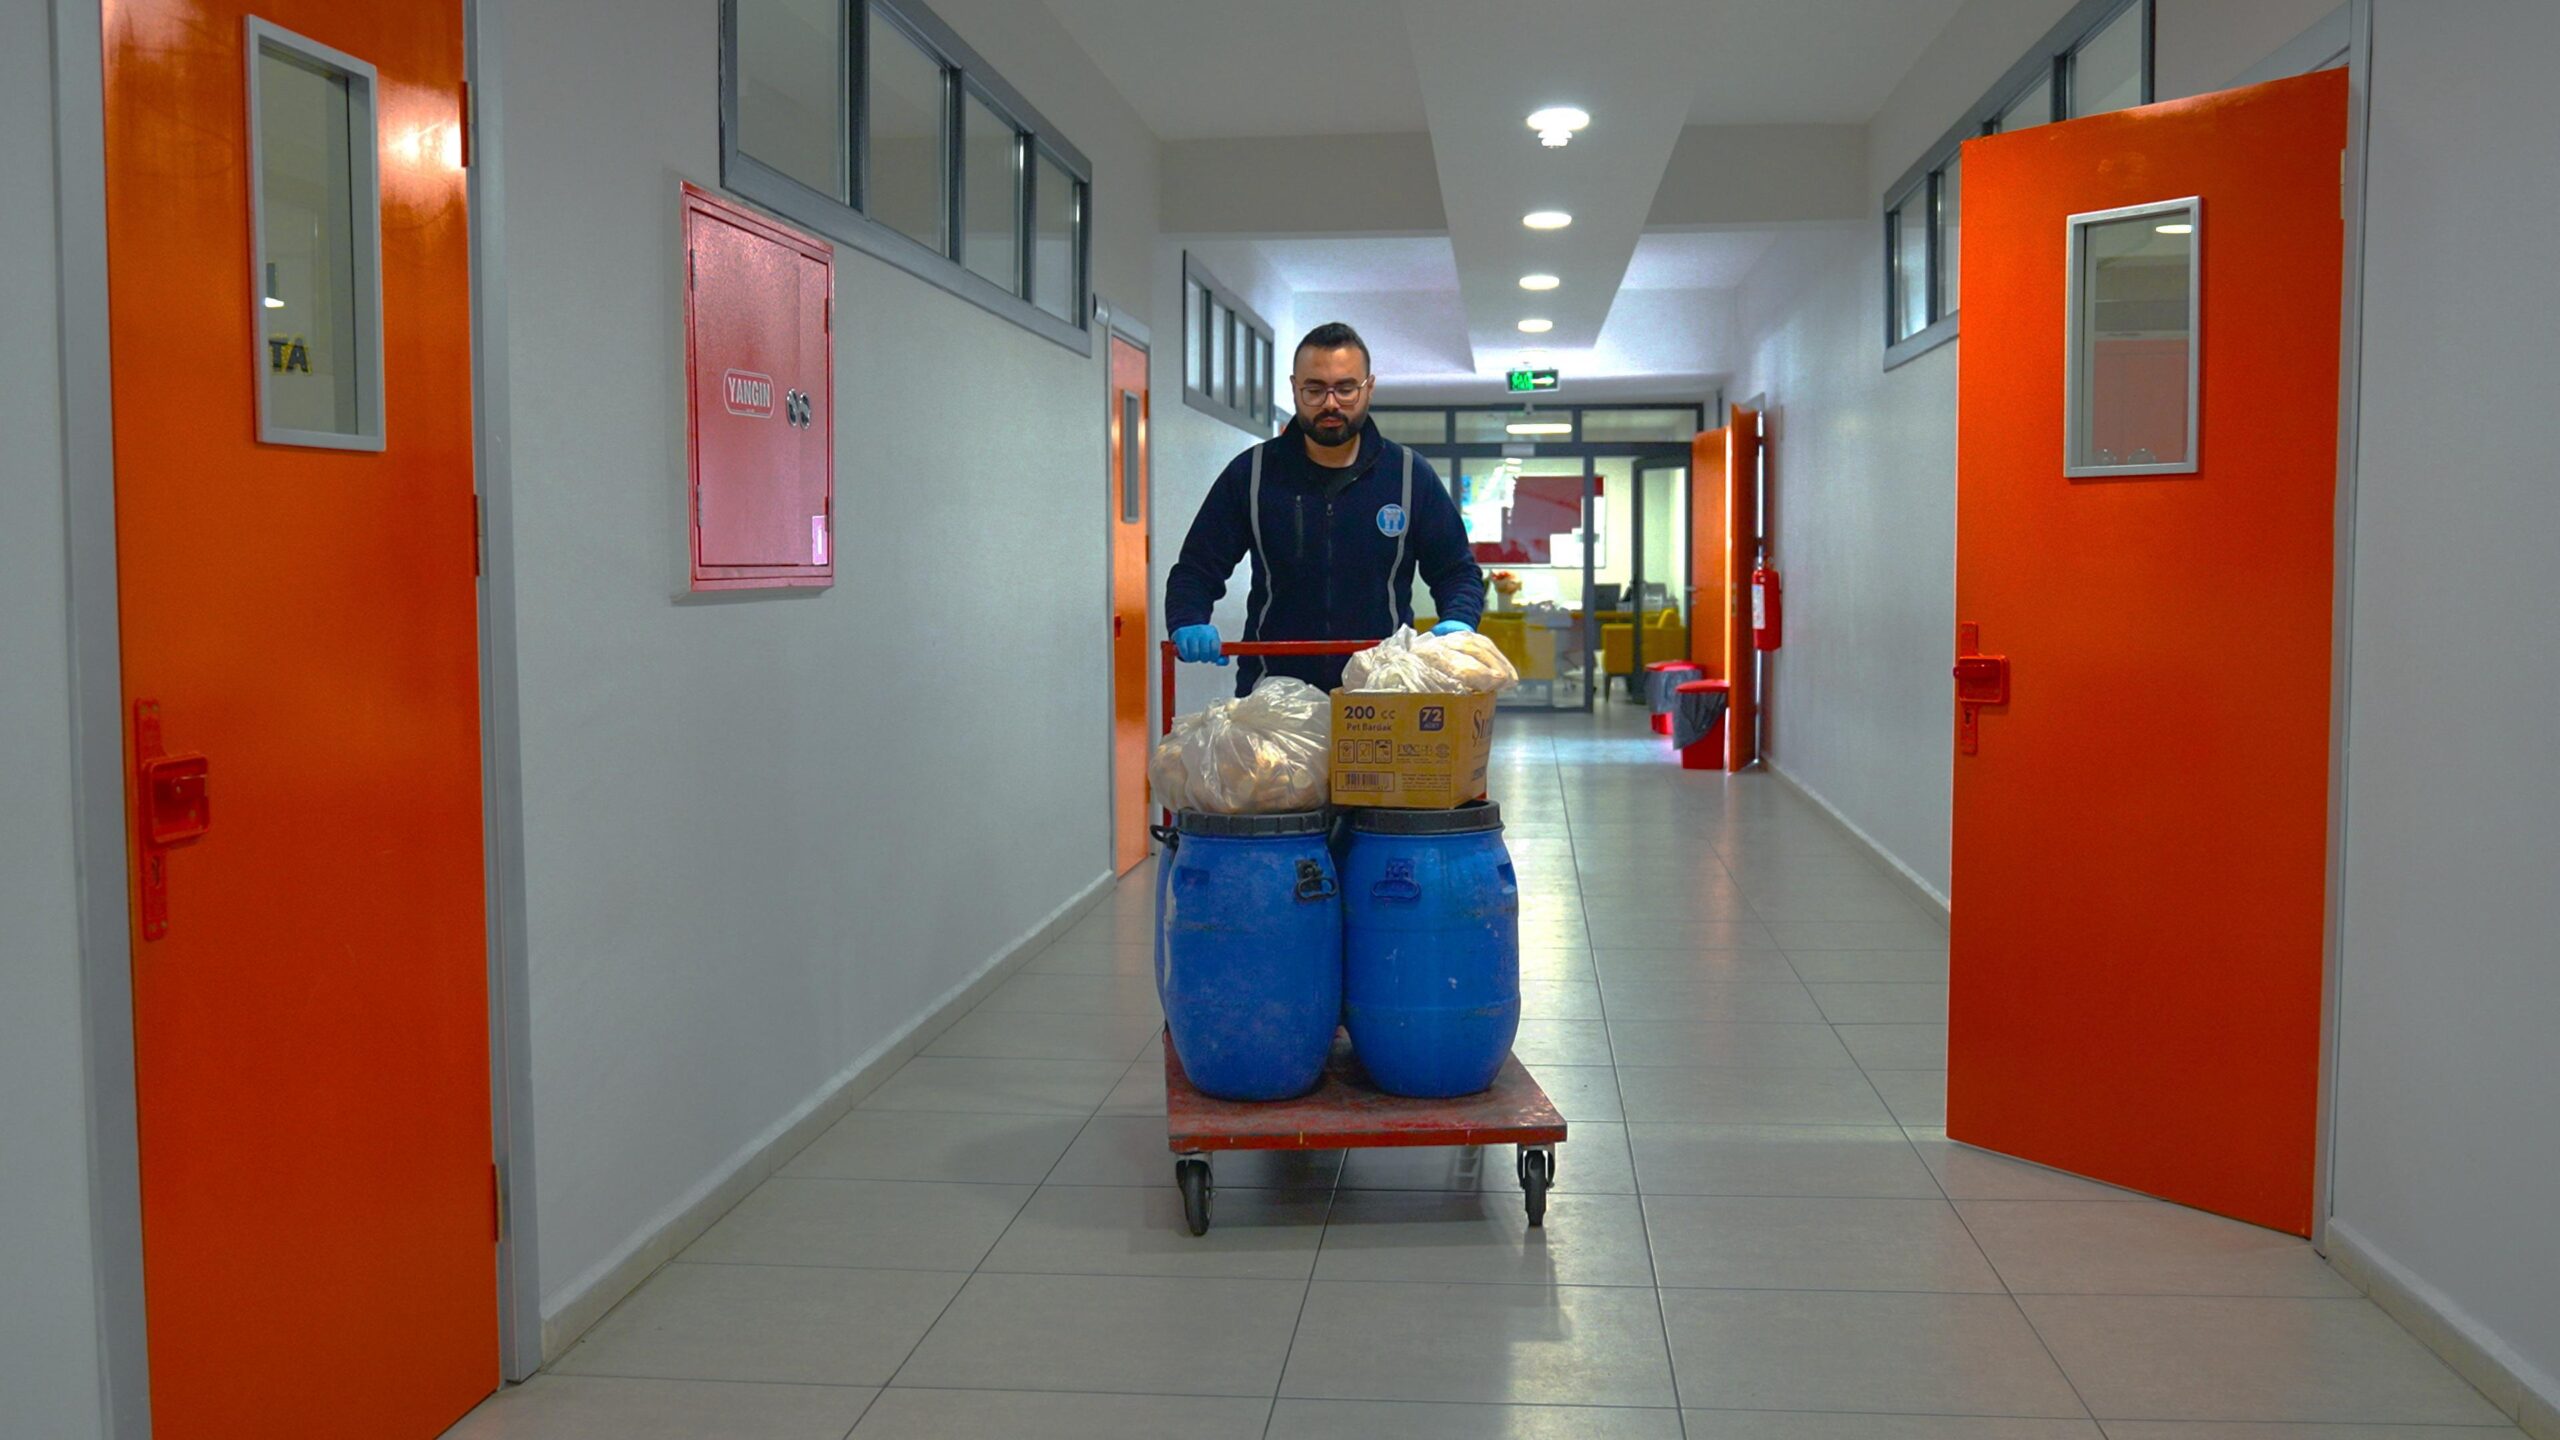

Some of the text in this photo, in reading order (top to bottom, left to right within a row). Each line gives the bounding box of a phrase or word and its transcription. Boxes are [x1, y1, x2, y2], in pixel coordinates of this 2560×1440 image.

[728, 377, 771, 408] YANGIN
[1343, 705, 1375, 720] 200
[1422, 709, 1442, 722] 72
